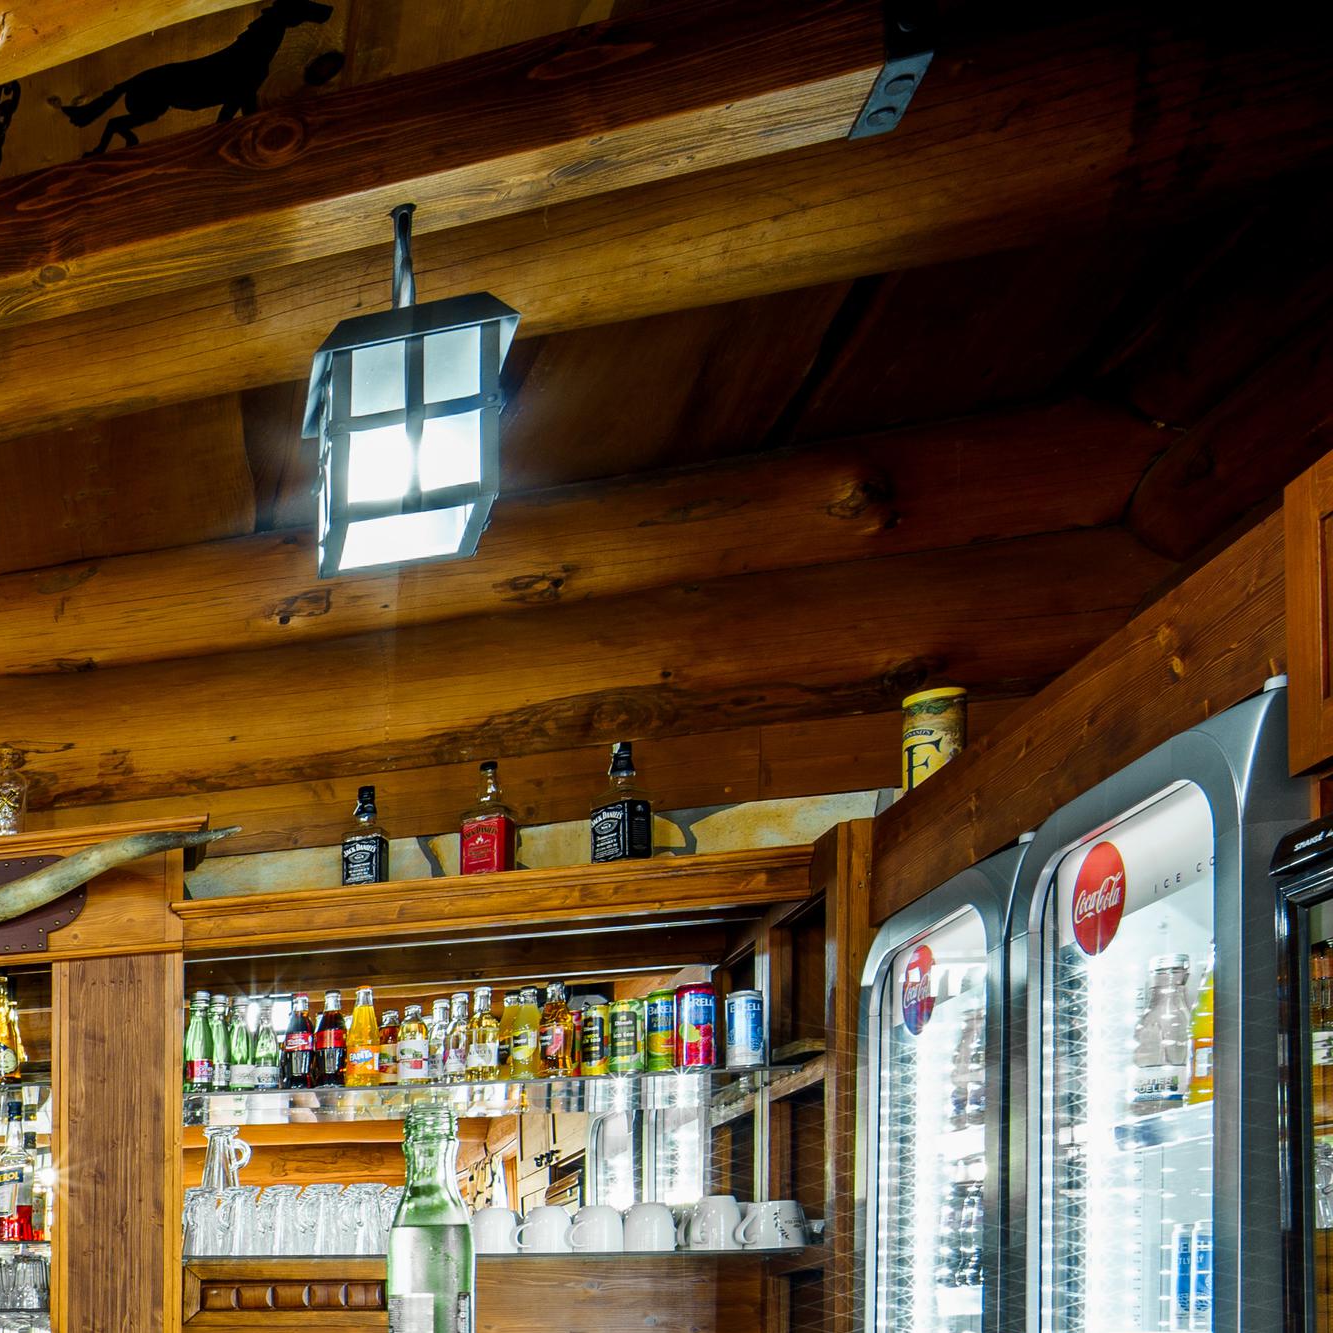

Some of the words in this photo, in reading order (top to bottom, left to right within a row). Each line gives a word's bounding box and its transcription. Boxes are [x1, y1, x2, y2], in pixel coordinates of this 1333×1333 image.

[1154, 872, 1181, 894] ICE
[1074, 870, 1123, 924] Coca-Cola
[349, 1049, 373, 1062] FANTA
